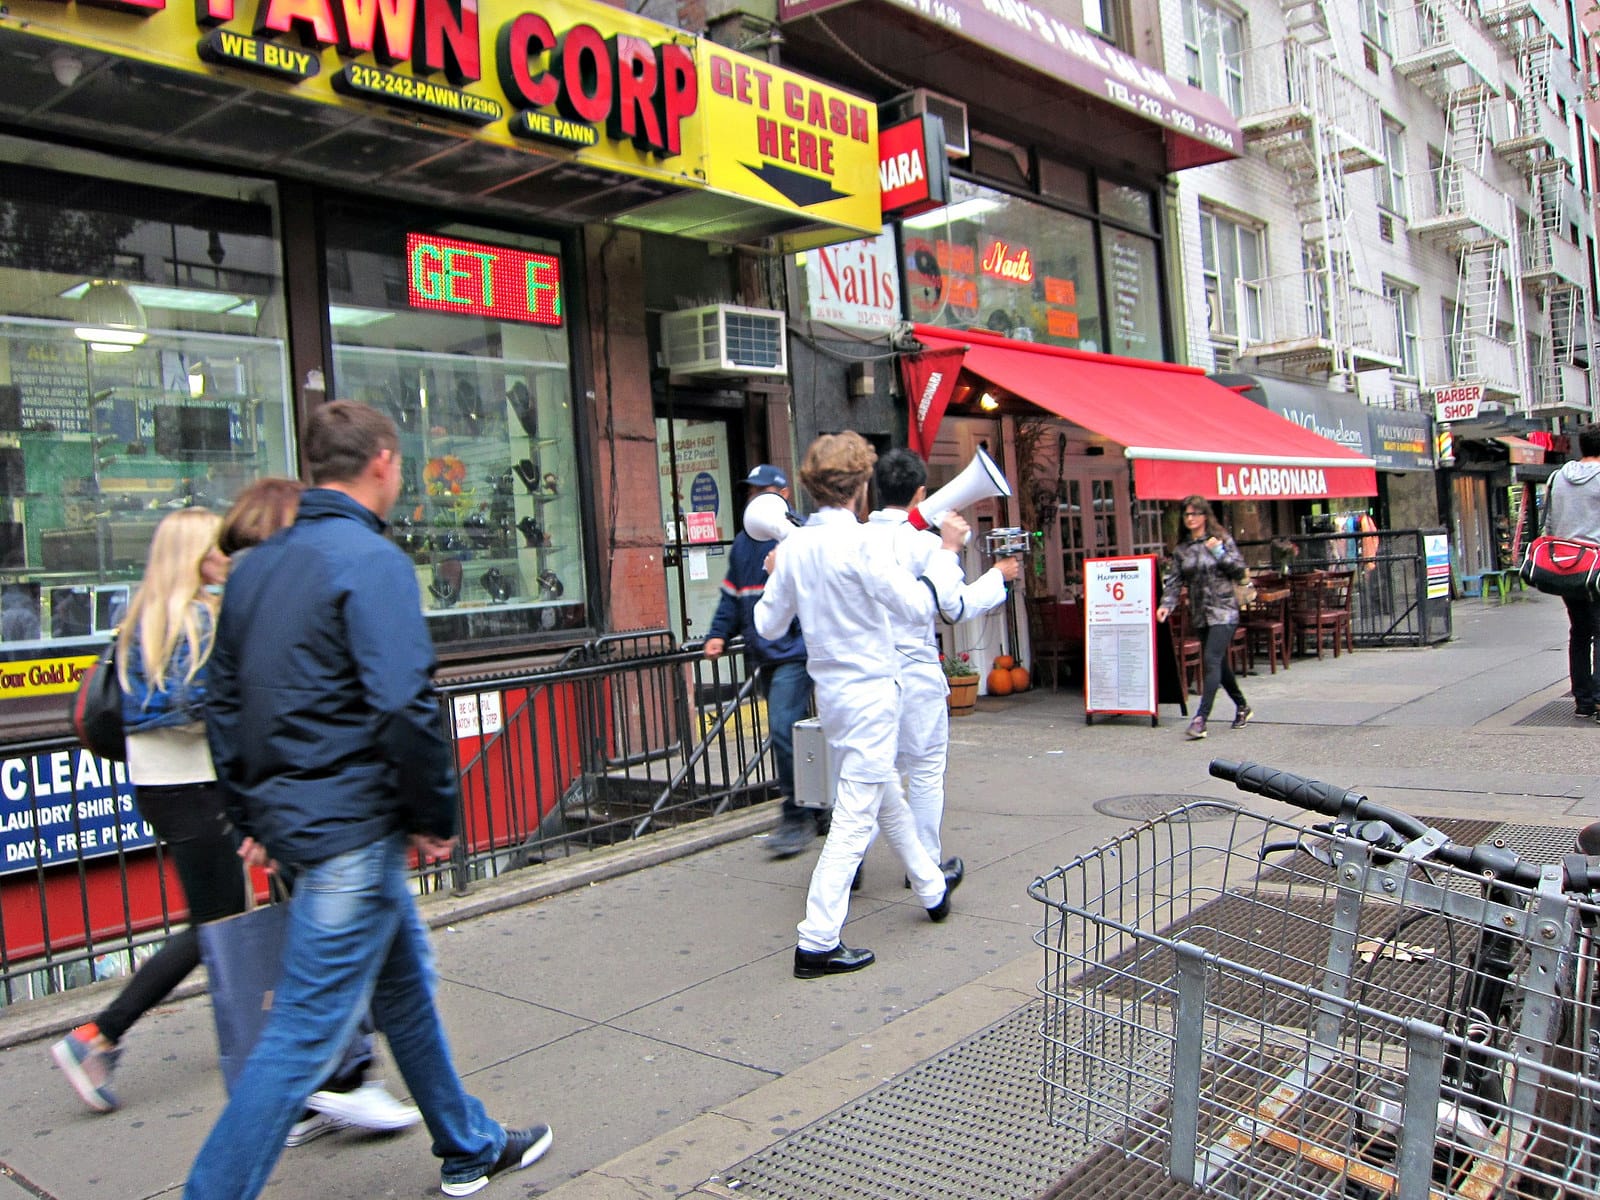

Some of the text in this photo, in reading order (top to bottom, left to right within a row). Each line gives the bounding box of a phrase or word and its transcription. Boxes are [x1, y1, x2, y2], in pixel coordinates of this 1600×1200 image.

[220, 32, 311, 75] WE BUY
[208, 0, 698, 156] AWN CORP
[351, 66, 460, 109] 212-242-PAWN
[710, 55, 869, 144] GET CASH
[527, 112, 595, 144] WE PAWN
[757, 116, 835, 175] HERE
[411, 244, 500, 307] GET
[817, 247, 895, 310] Nails
[983, 241, 1032, 282] Nails
[1436, 386, 1481, 404] BARBER
[1444, 403, 1474, 419] SHOP
[1216, 466, 1328, 496] LA CARBONARA
[689, 525, 716, 540] OPEN
[1105, 581, 1125, 602] $6
[29, 663, 65, 686] Gold
[68, 662, 87, 683] Je
[1, 749, 132, 801] CLEAN
[57, 830, 98, 852] FREE
[102, 821, 139, 844] PICK
